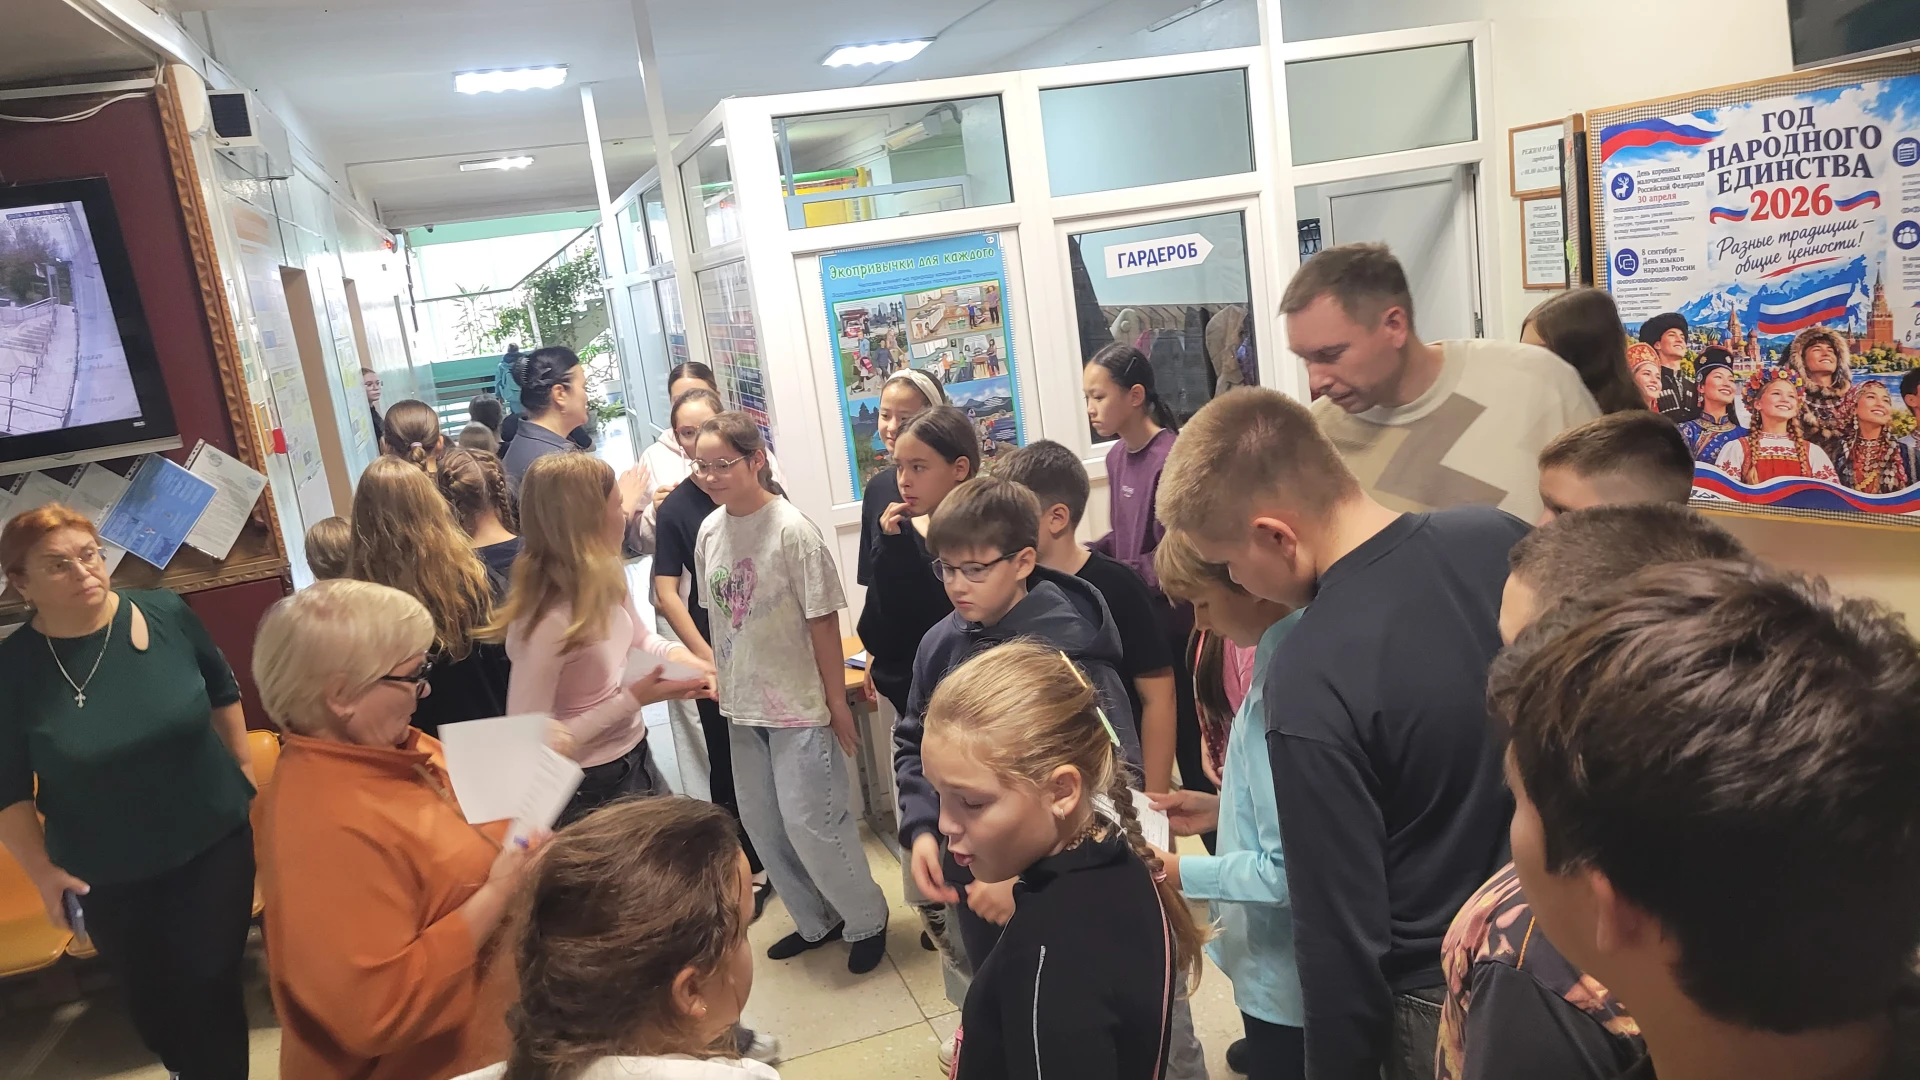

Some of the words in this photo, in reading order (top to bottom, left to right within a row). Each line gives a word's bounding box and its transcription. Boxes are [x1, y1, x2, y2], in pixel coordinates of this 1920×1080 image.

[1762, 106, 1815, 133] ГОД
[1707, 125, 1882, 172] НАРОДНОГО
[1637, 170, 1651, 178] День
[1717, 153, 1874, 195] ЕДИНСТВА
[1637, 183, 1670, 194] Российской
[1637, 195, 1647, 203] 30
[1649, 193, 1677, 203] апреля
[1750, 183, 1833, 222] 2026
[1647, 247, 1677, 256] сентября
[1716, 236, 1774, 261] Разные
[1778, 219, 1859, 248] традиции
[1735, 252, 1782, 275] общие
[1787, 231, 1865, 264] ценности!
[829, 258, 914, 280] Экопривычки
[918, 254, 940, 268] для
[943, 247, 995, 265] каждого
[1117, 242, 1198, 269] ГАРДЕРОБ
[1642, 257, 1658, 266] День
[1659, 256, 1685, 264] языков
[1643, 266, 1670, 275] народов
[1671, 264, 1696, 272] России
